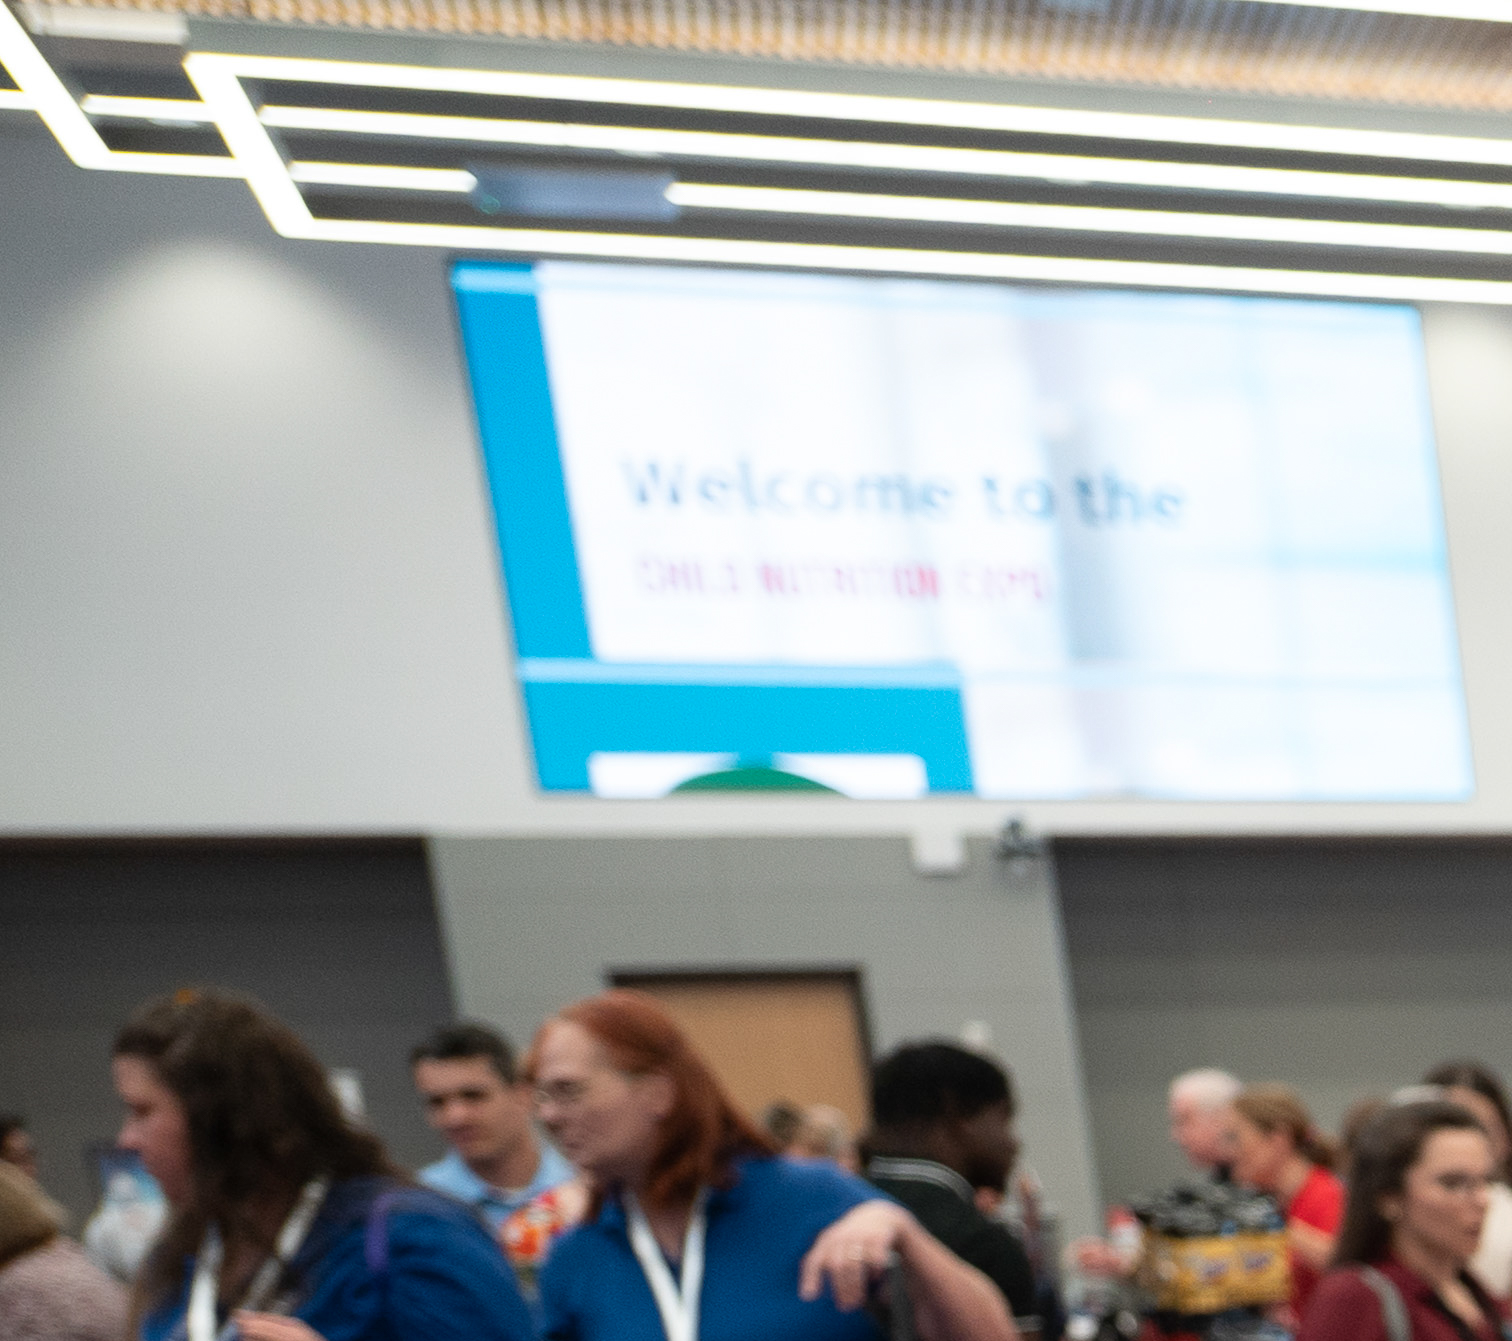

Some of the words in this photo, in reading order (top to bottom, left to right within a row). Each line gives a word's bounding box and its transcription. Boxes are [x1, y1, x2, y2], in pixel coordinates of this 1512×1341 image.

[622, 454, 953, 518] Welcome
[984, 472, 1056, 523] to
[1078, 470, 1187, 528] the
